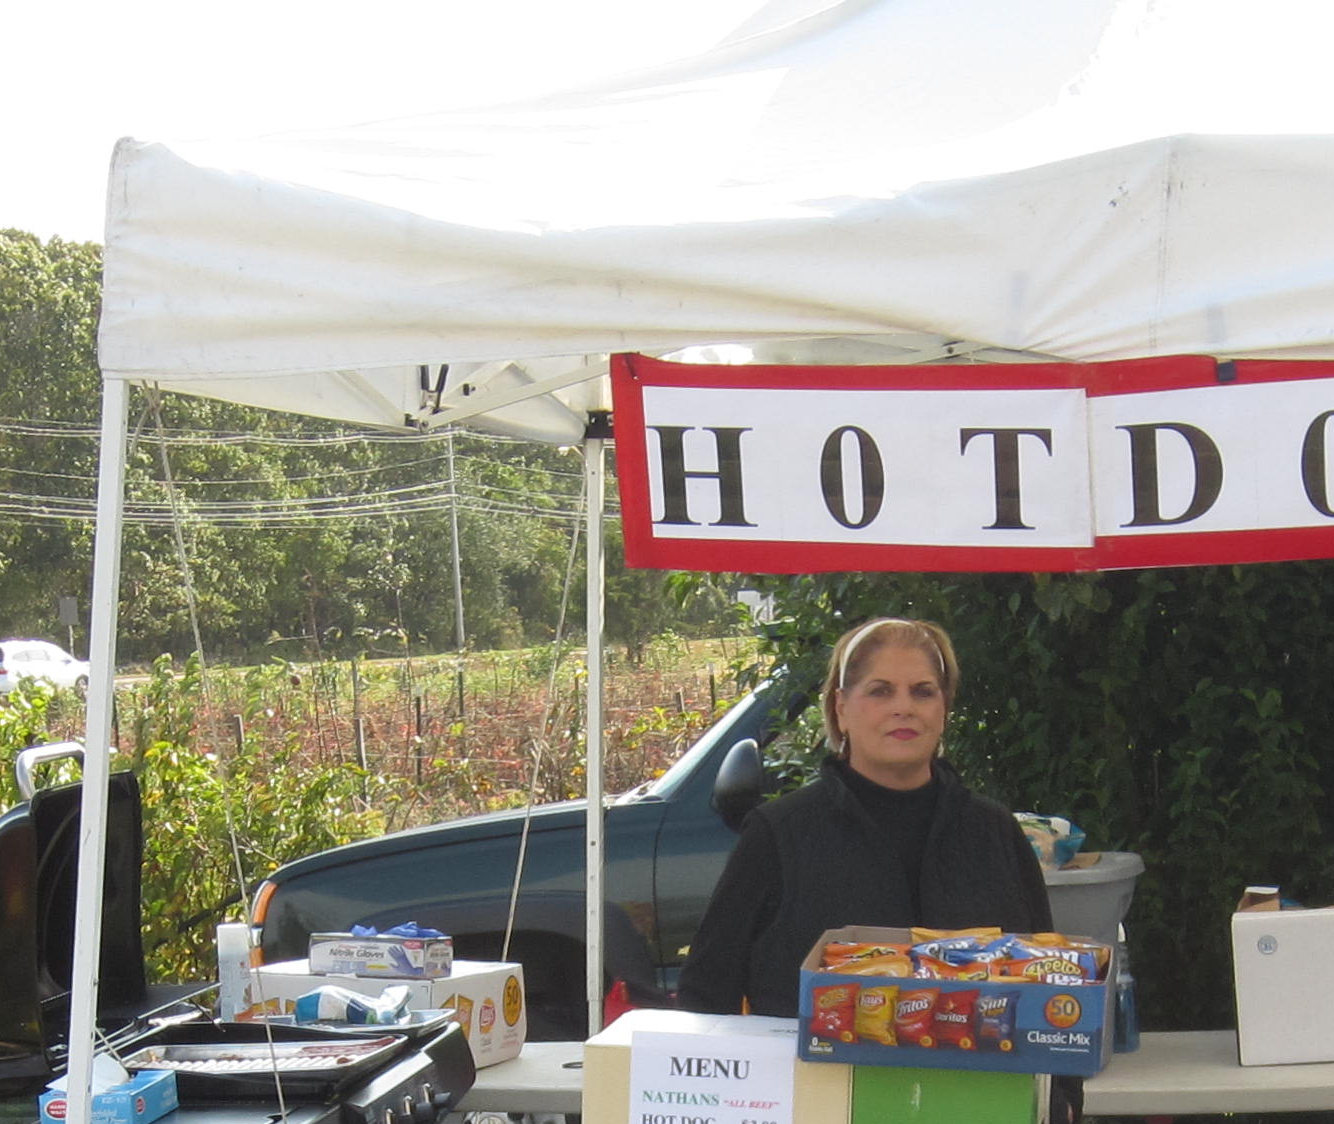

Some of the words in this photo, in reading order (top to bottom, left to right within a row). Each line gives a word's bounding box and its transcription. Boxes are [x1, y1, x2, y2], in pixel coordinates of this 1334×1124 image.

[356, 948, 385, 959] Gloves
[898, 998, 929, 1016] Fritos
[1052, 1000, 1075, 1017] 50
[1027, 1031, 1067, 1044] Classic
[1068, 1033, 1091, 1046] Mix
[670, 1056, 750, 1080] MENU
[642, 1090, 720, 1106] NATHANS
